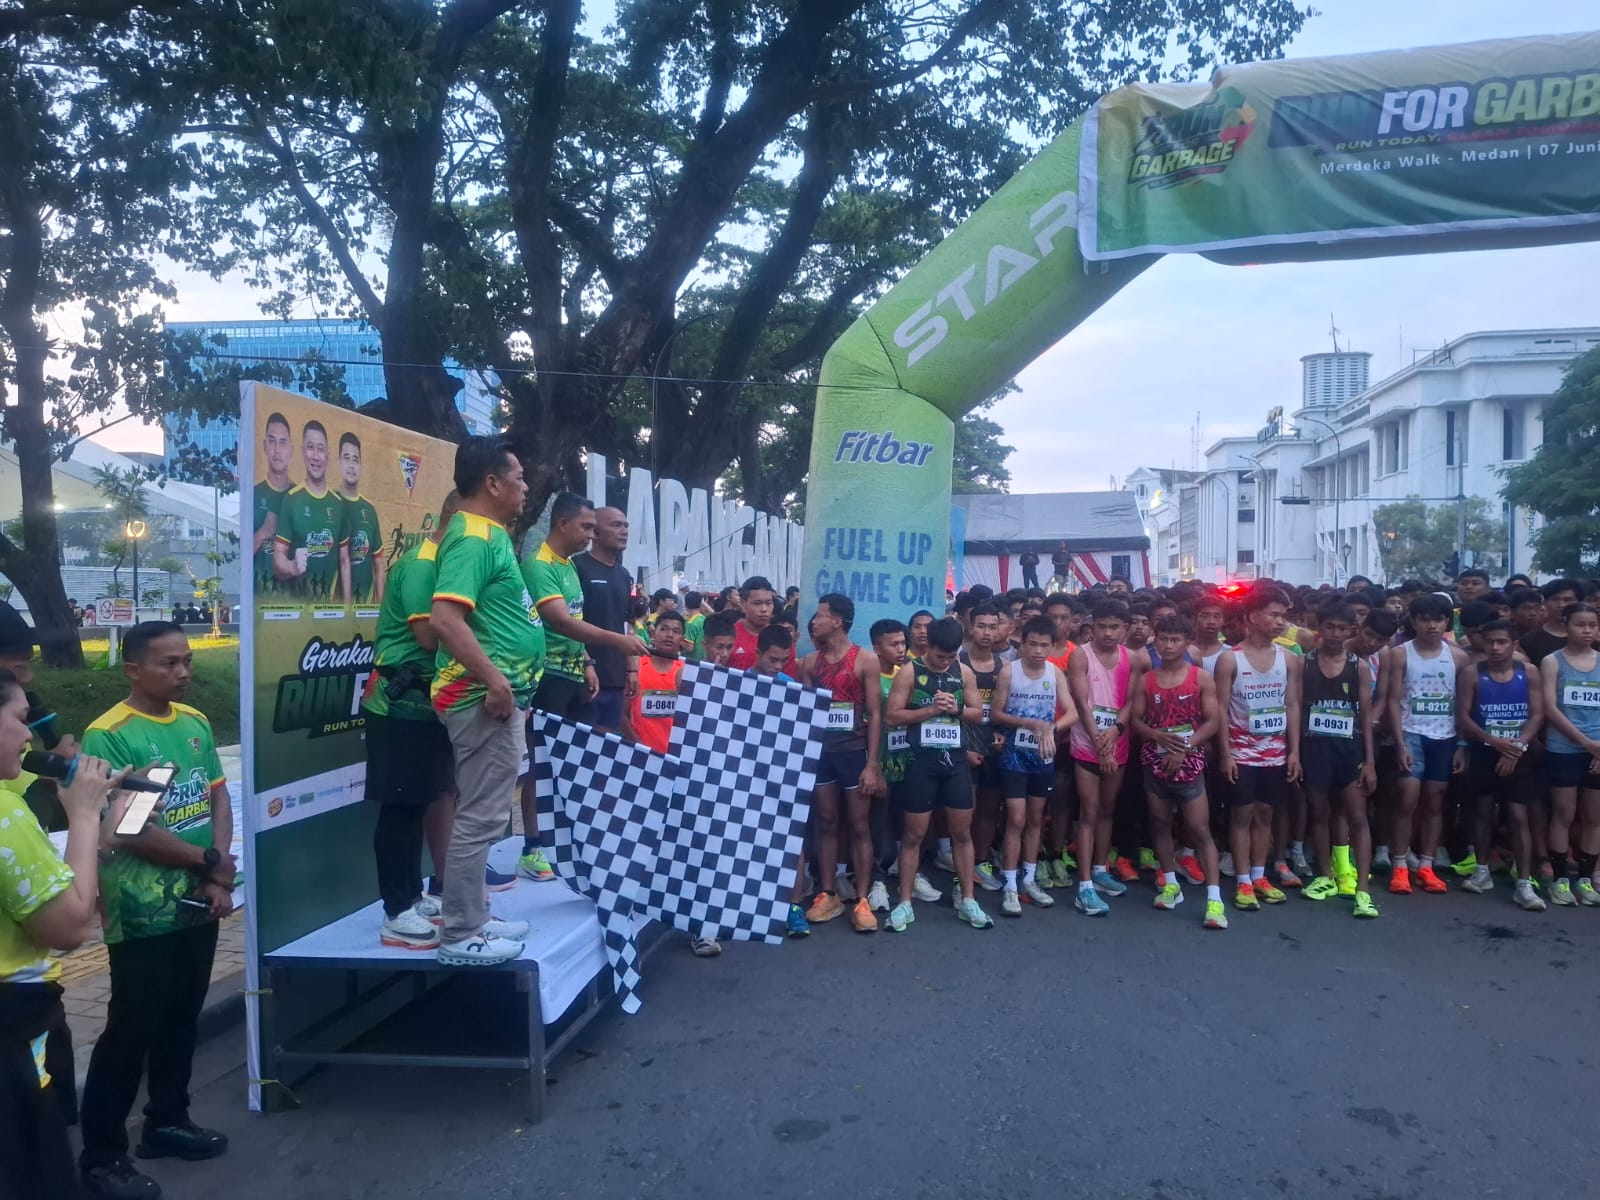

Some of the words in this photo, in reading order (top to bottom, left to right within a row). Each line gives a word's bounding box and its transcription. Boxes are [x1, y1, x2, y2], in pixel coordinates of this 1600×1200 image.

[1378, 88, 1468, 134] FOR
[1336, 140, 1372, 151] RUN
[1131, 139, 1236, 179] GARBAGE
[1320, 159, 1391, 174] Merdeka
[1398, 154, 1440, 168] Walk
[1461, 147, 1520, 162] Medan
[1539, 143, 1559, 155] 07
[834, 430, 934, 467] Fitbar
[823, 527, 888, 563] FUEL
[898, 532, 932, 564] UP
[815, 572, 889, 605] GAME
[900, 575, 933, 606] ON
[646, 698, 675, 710] B-0841
[1416, 701, 1450, 712] M-0212
[828, 713, 850, 724] 0760
[1254, 717, 1284, 728] B-1023
[1314, 717, 1349, 730] B-0931
[323, 722, 348, 733] RUN
[351, 719, 366, 727] TO
[925, 728, 957, 740] B-0835
[181, 781, 207, 801] RUN
